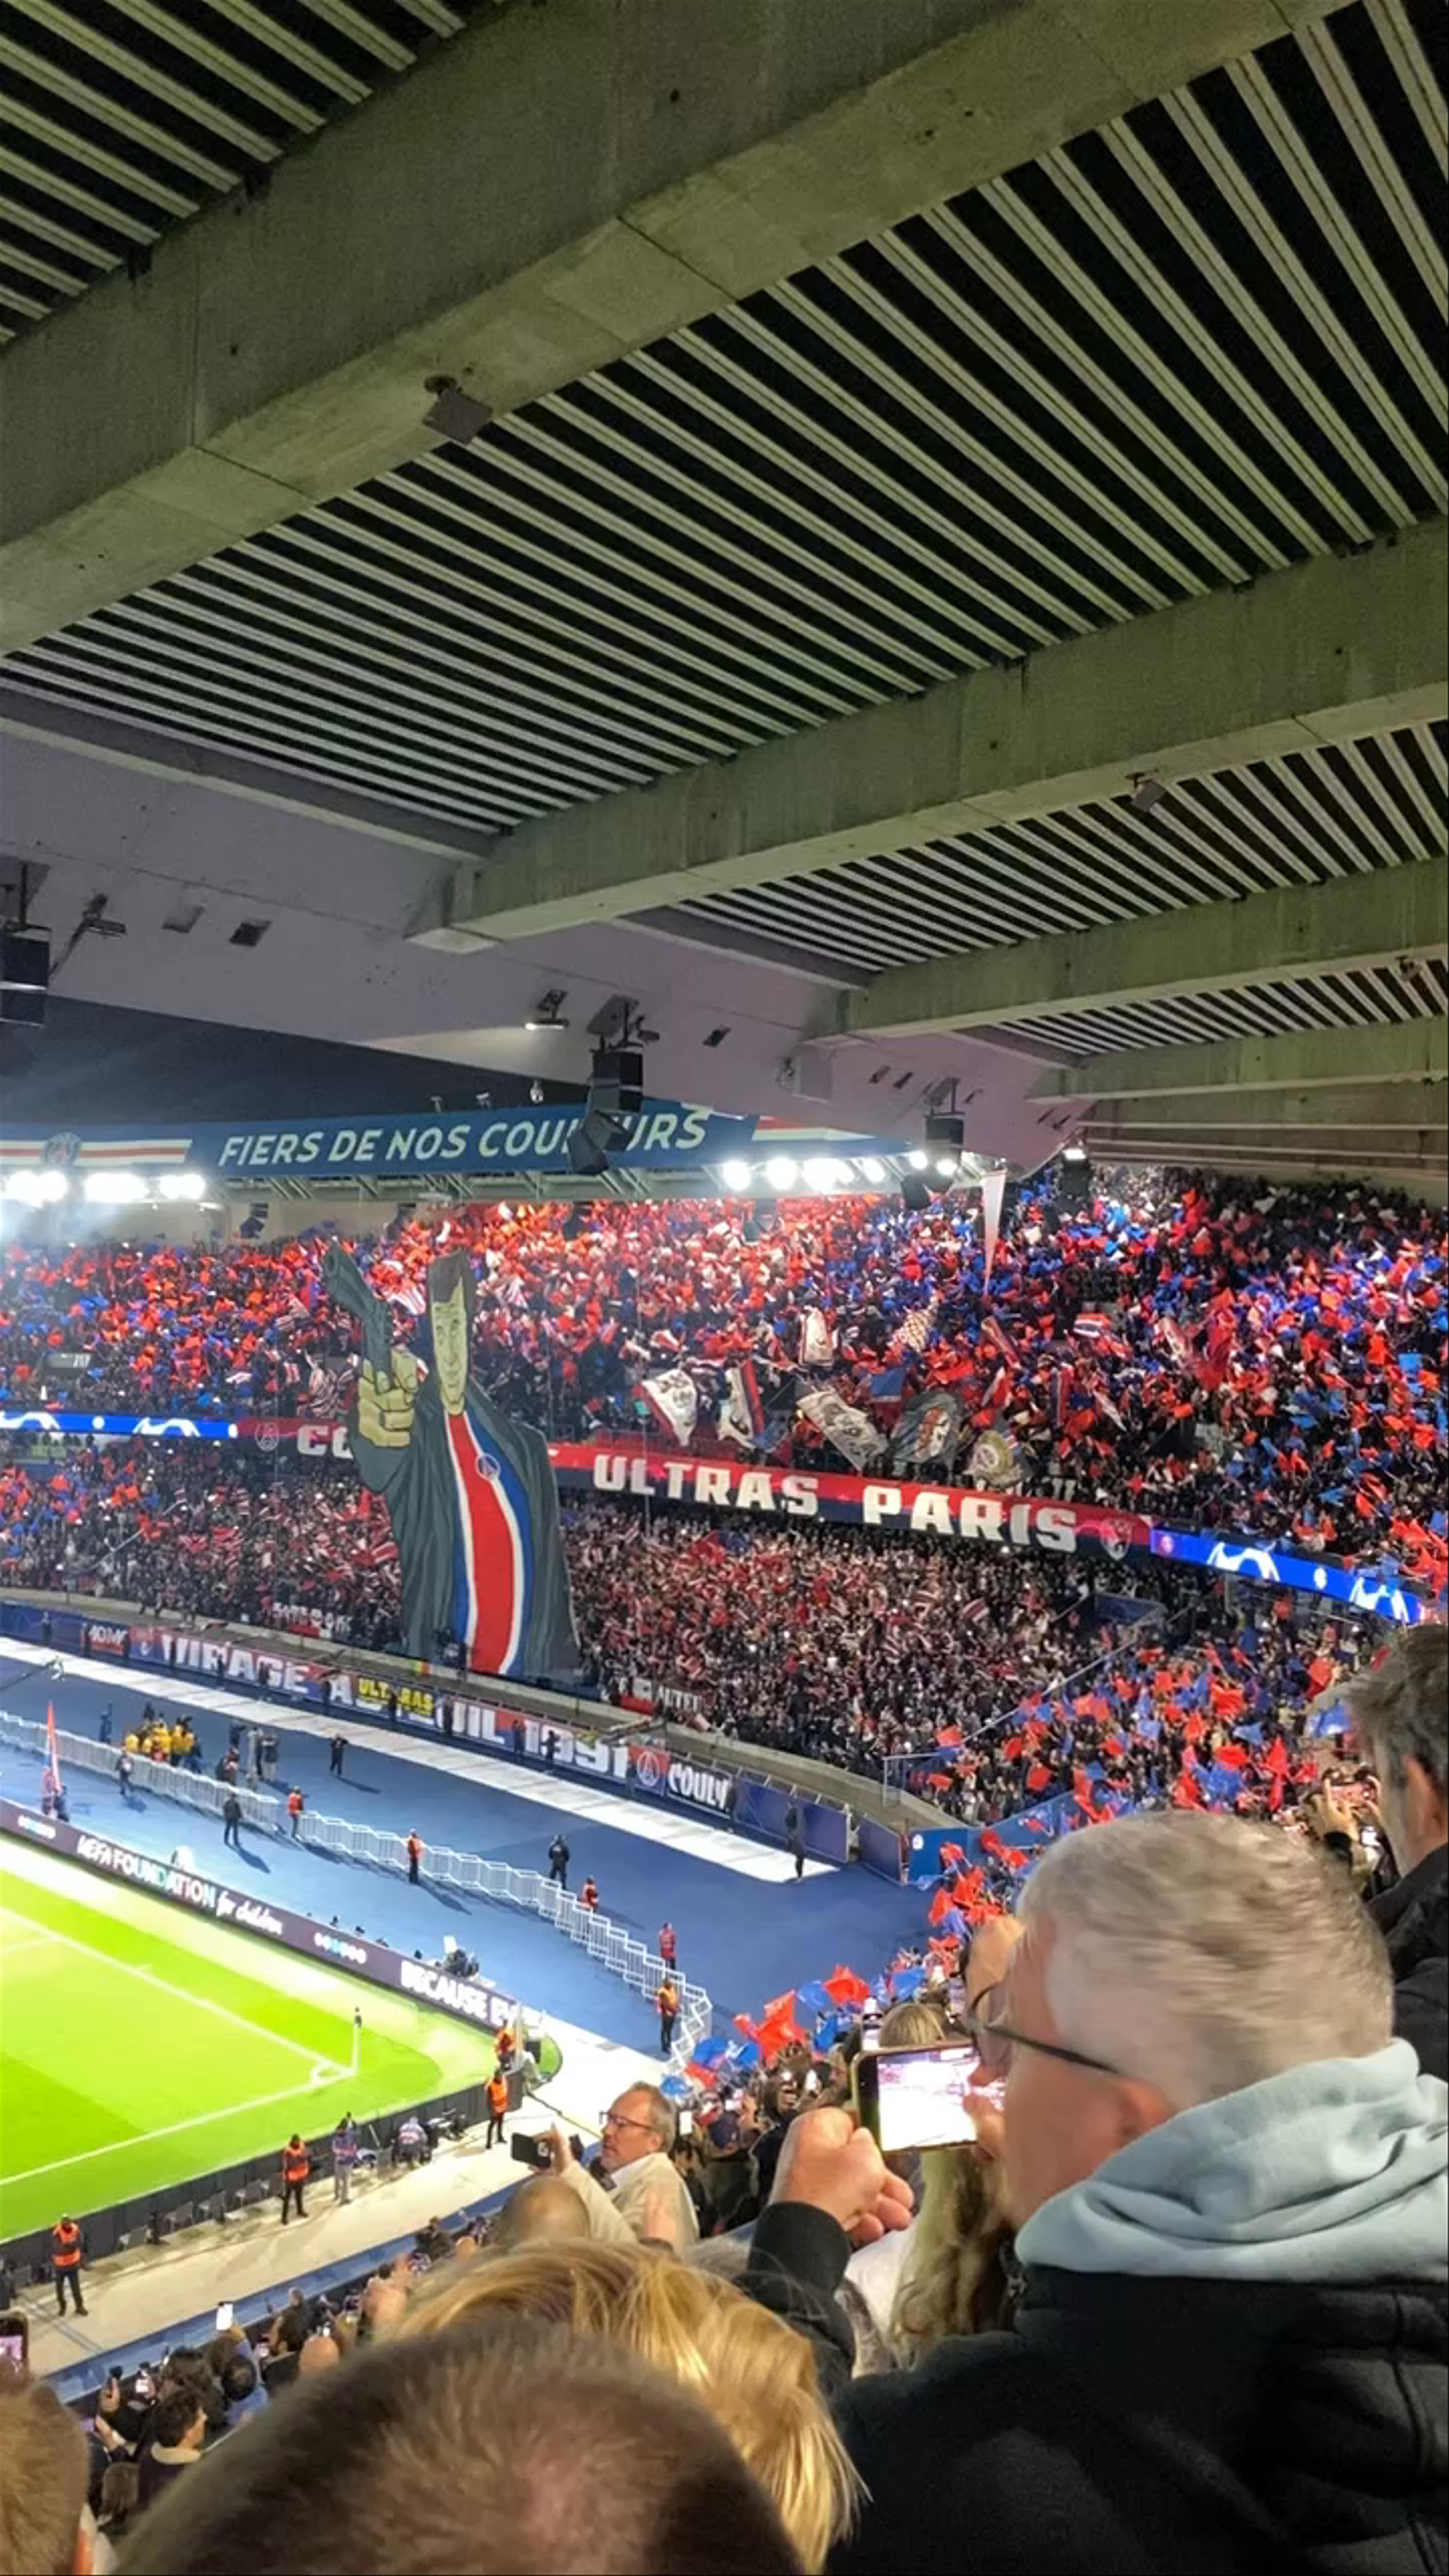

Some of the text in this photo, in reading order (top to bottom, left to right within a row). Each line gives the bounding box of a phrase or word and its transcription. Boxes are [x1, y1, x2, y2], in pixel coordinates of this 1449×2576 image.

[218, 1131, 326, 1167] FIERS
[328, 1127, 383, 1162] DE
[385, 1124, 471, 1161] NOS
[593, 1454, 1077, 1553] ULTRAS PARIS
